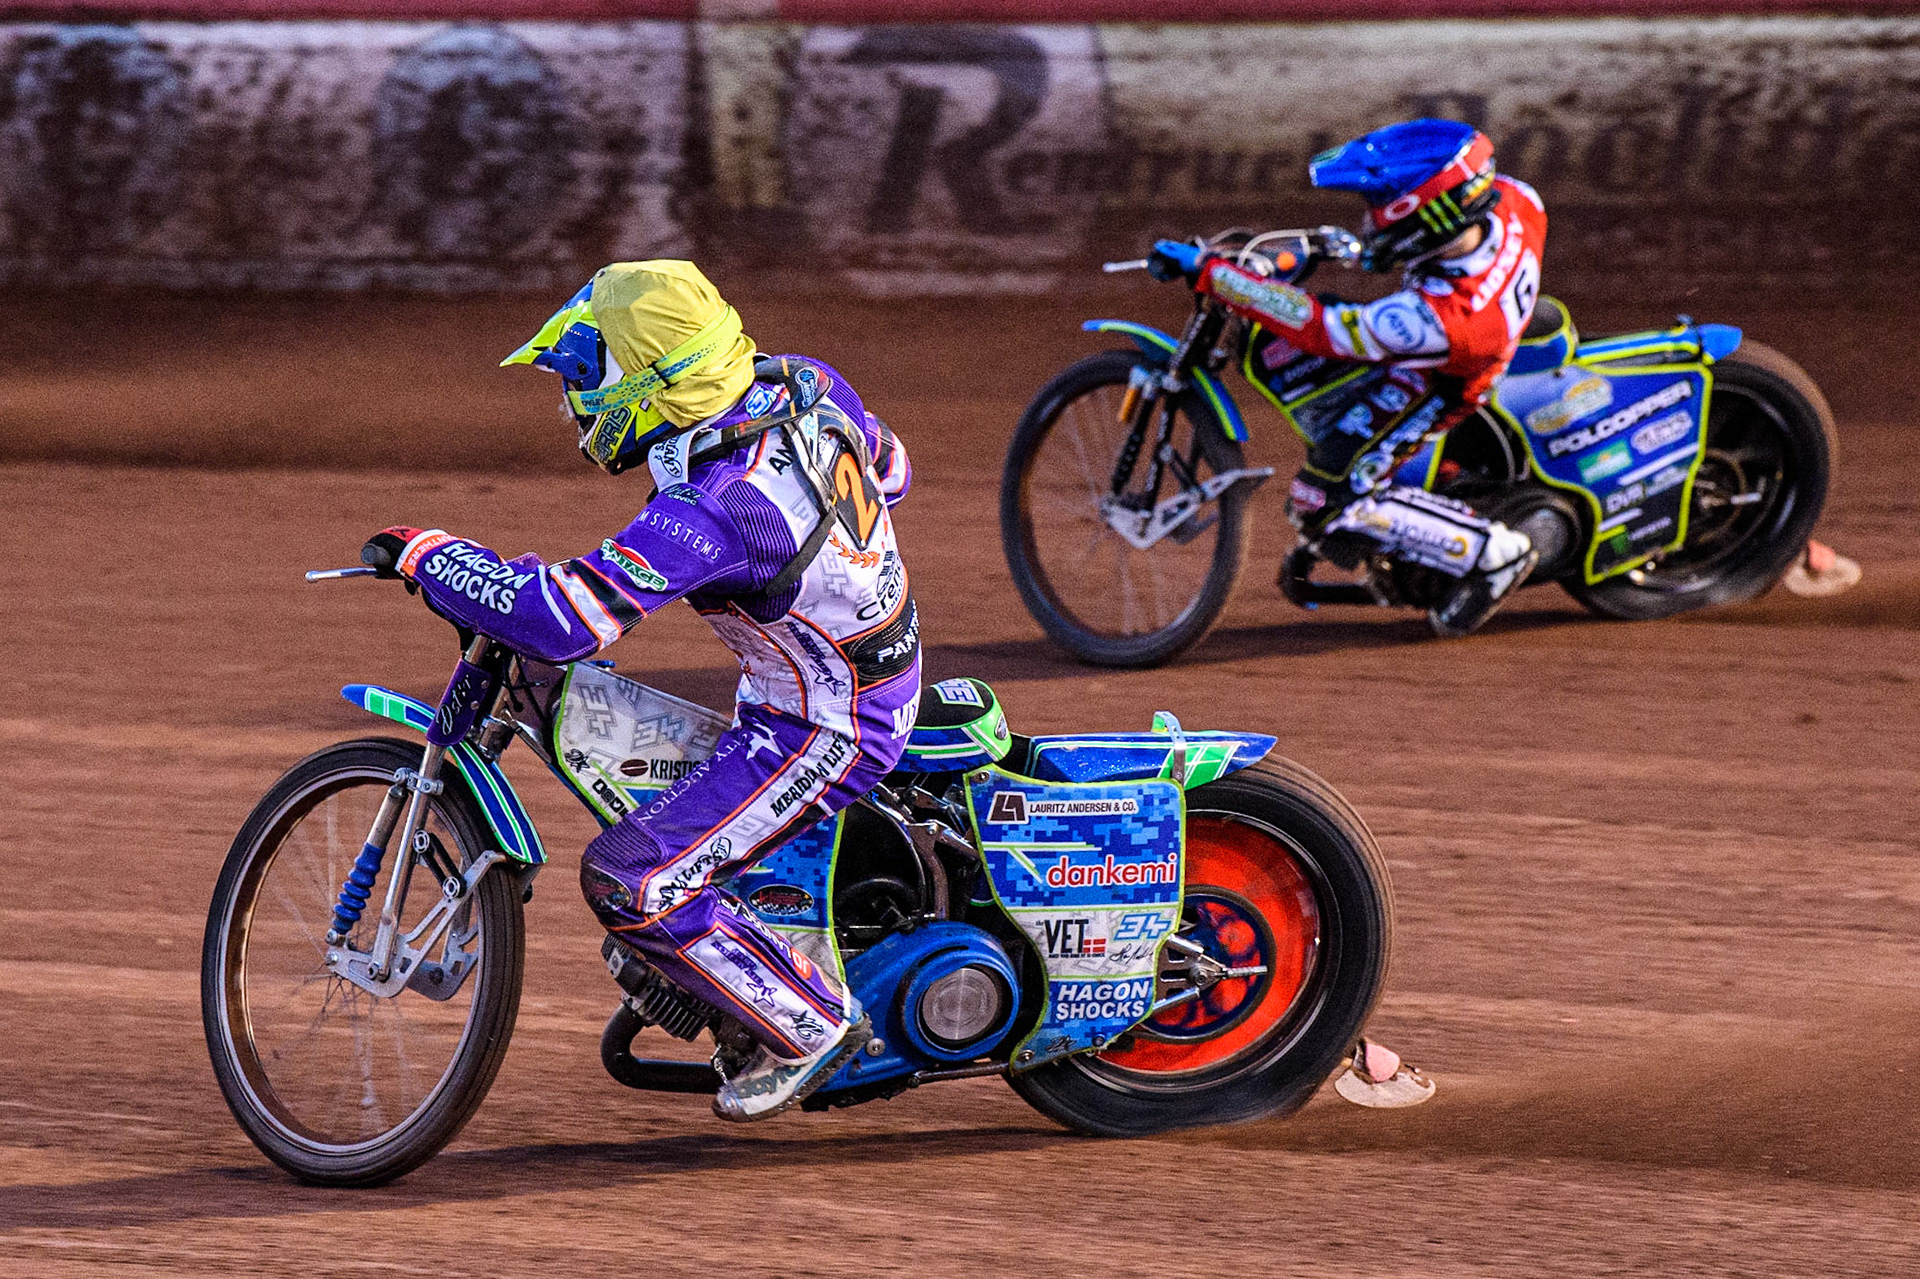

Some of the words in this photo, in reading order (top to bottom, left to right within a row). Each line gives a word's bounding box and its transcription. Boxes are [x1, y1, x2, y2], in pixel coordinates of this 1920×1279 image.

[834, 451, 881, 540] 2
[650, 512, 722, 560] SYSTEMS
[424, 554, 516, 614] SHOCKS
[441, 542, 536, 590] HAGON
[649, 758, 703, 780] KRISTI
[637, 760, 711, 827] AUCTION
[770, 758, 830, 818] MERIDIAN
[1029, 803, 1066, 815] LAURITZ
[1067, 802, 1113, 814] ANDERSEN
[1114, 801, 1122, 813] &
[1122, 801, 1137, 813] CO.
[1046, 855, 1177, 888] dankemi
[1044, 918, 1090, 954] VET
[1112, 912, 1173, 942] 34
[1058, 979, 1150, 1002] HAGON
[1055, 1000, 1146, 1021] SHOCKS
